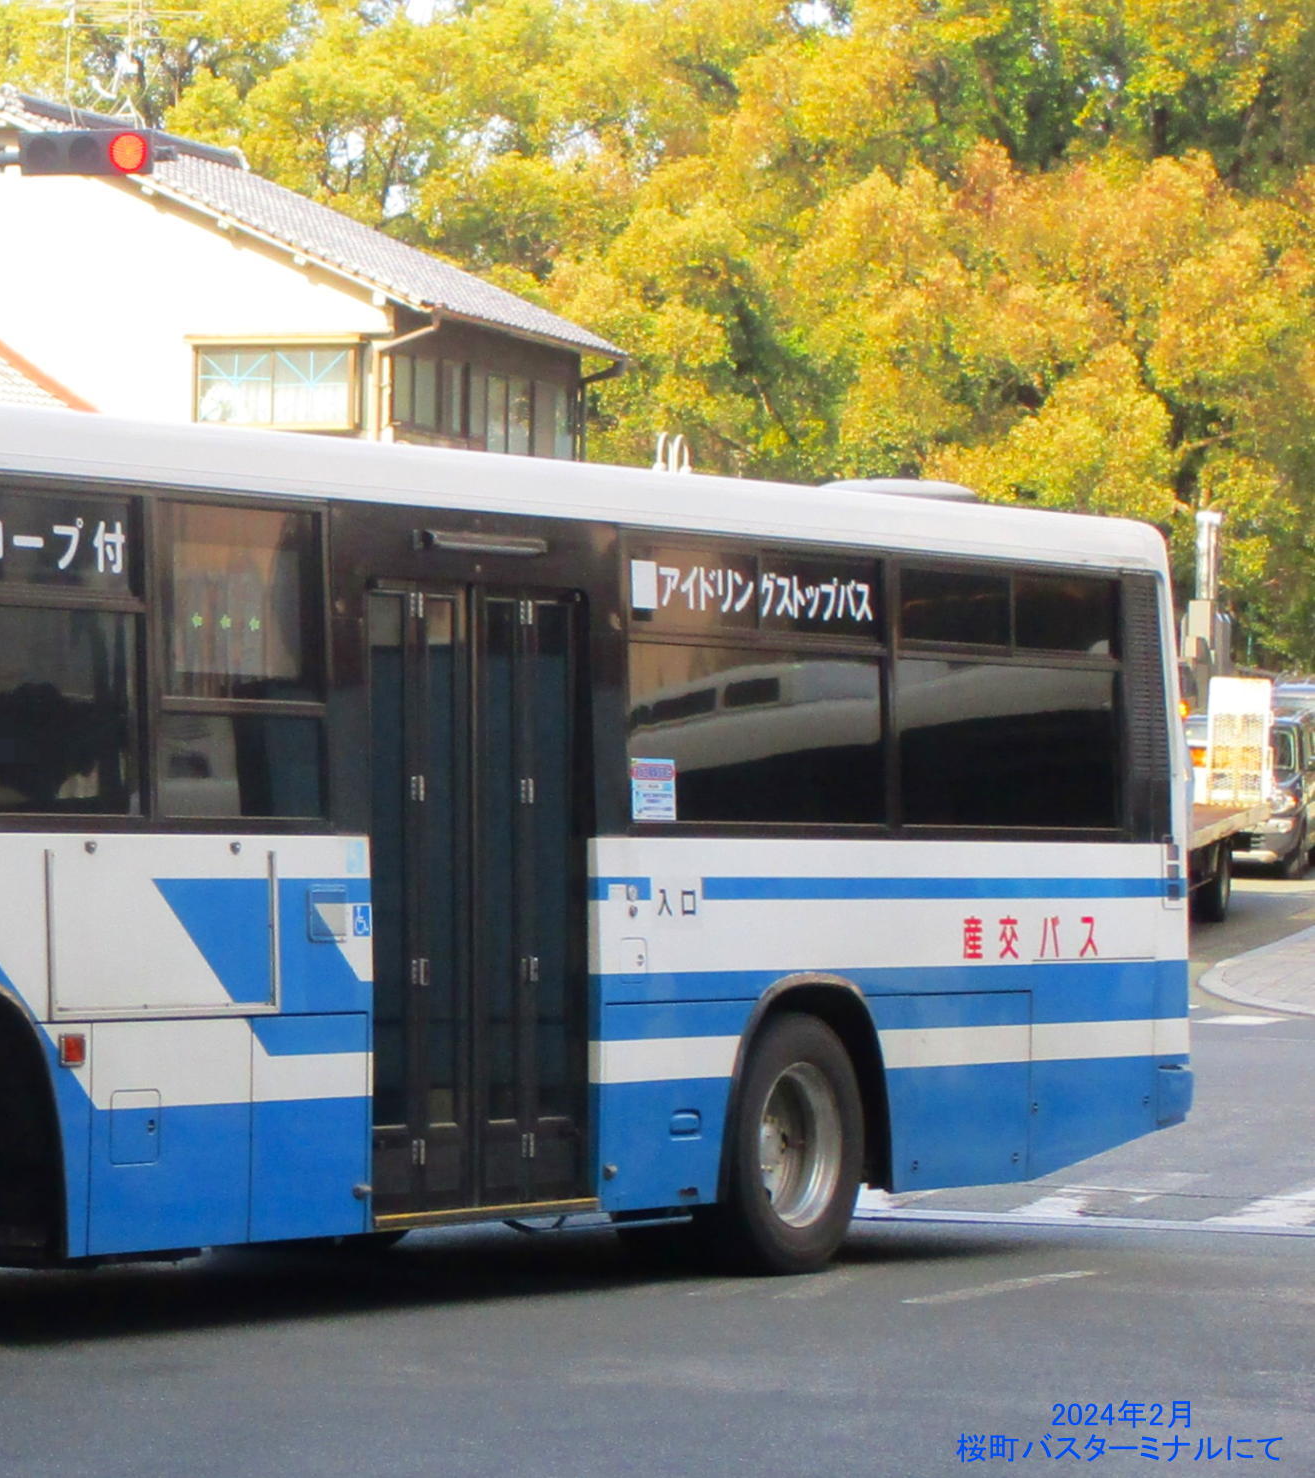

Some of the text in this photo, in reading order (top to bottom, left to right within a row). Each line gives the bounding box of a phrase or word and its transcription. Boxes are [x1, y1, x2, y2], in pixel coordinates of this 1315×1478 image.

[658, 565, 874, 622] アイドリングストップバス
[657, 888, 697, 917] 入口
[962, 914, 1099, 960] 産交バス
